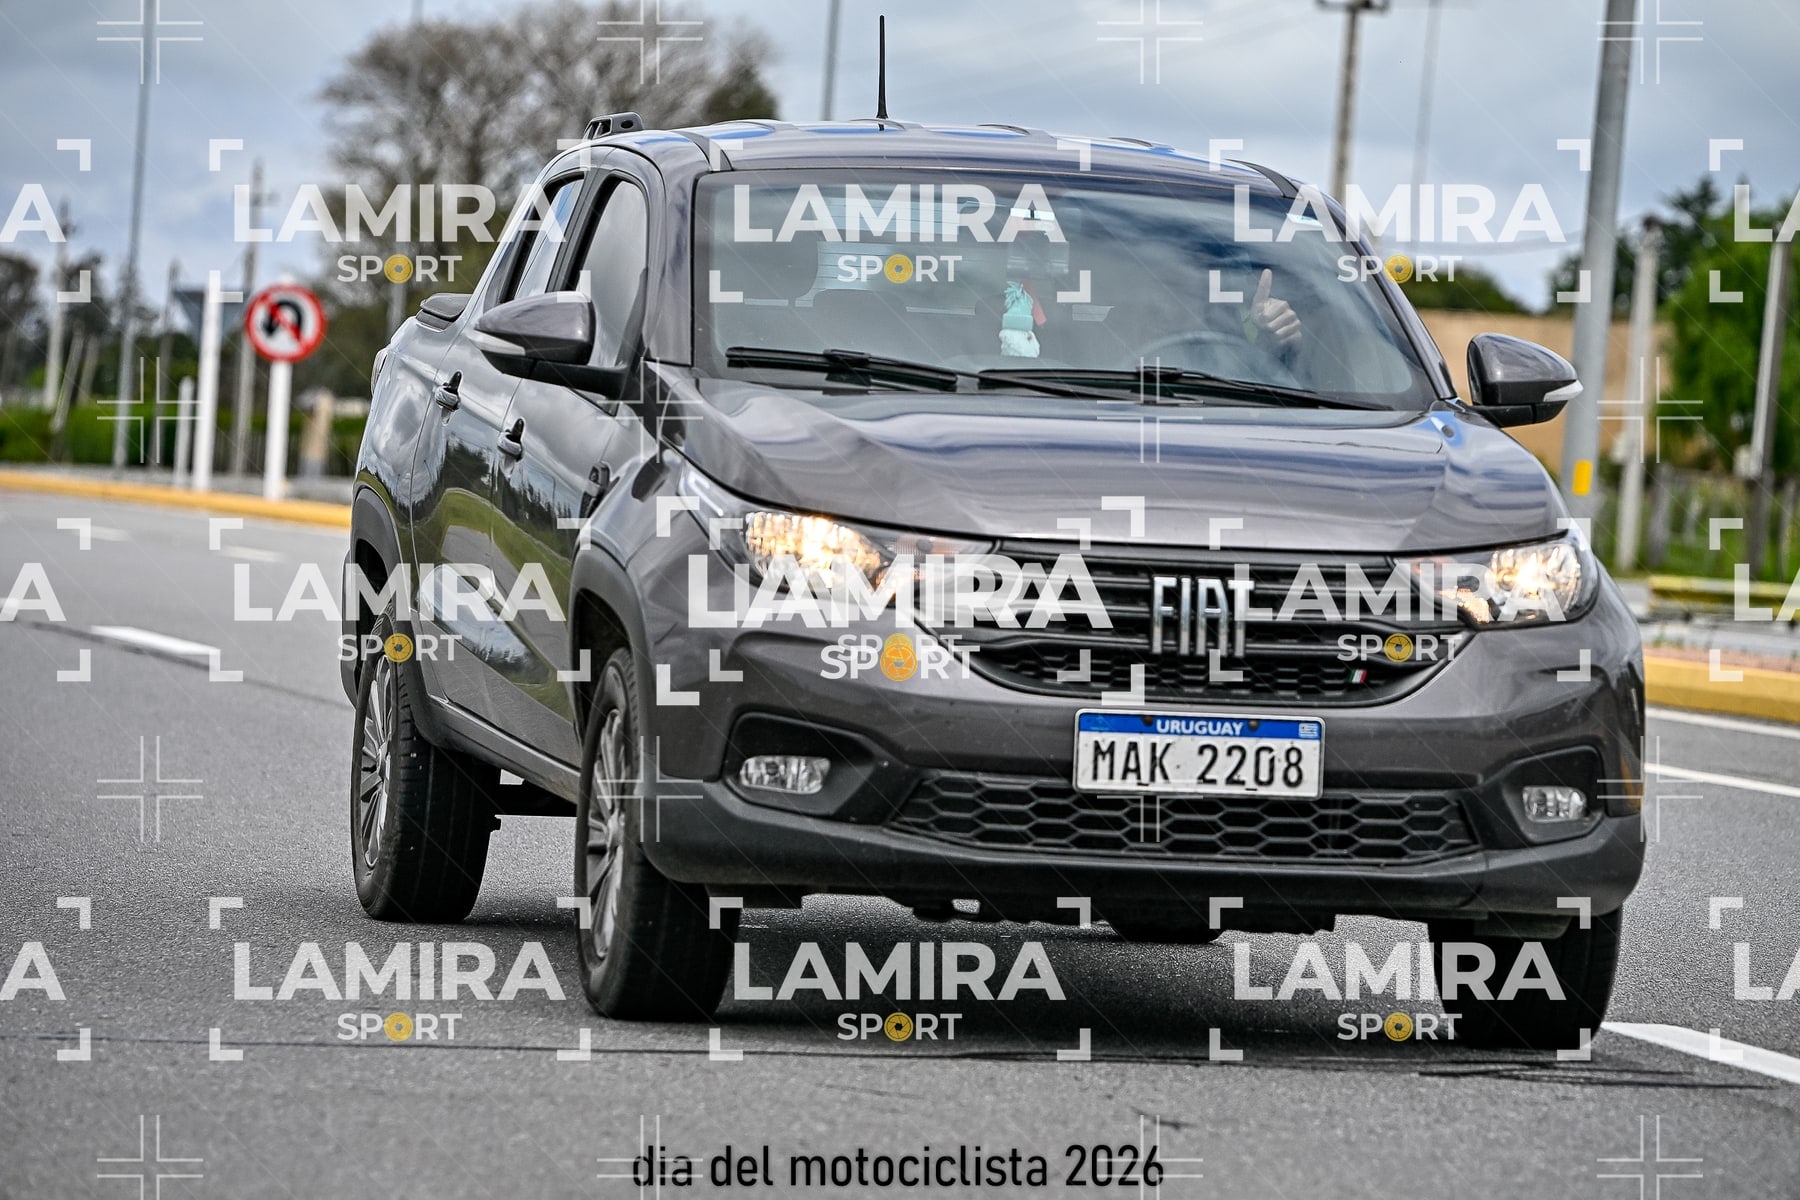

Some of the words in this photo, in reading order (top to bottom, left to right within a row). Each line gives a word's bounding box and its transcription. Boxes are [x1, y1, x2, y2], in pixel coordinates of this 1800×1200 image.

[1152, 576, 1255, 657] FIAT
[1156, 719, 1243, 736] URUGUAY
[1092, 740, 1173, 783] MAK
[1197, 744, 1304, 788] 2208
